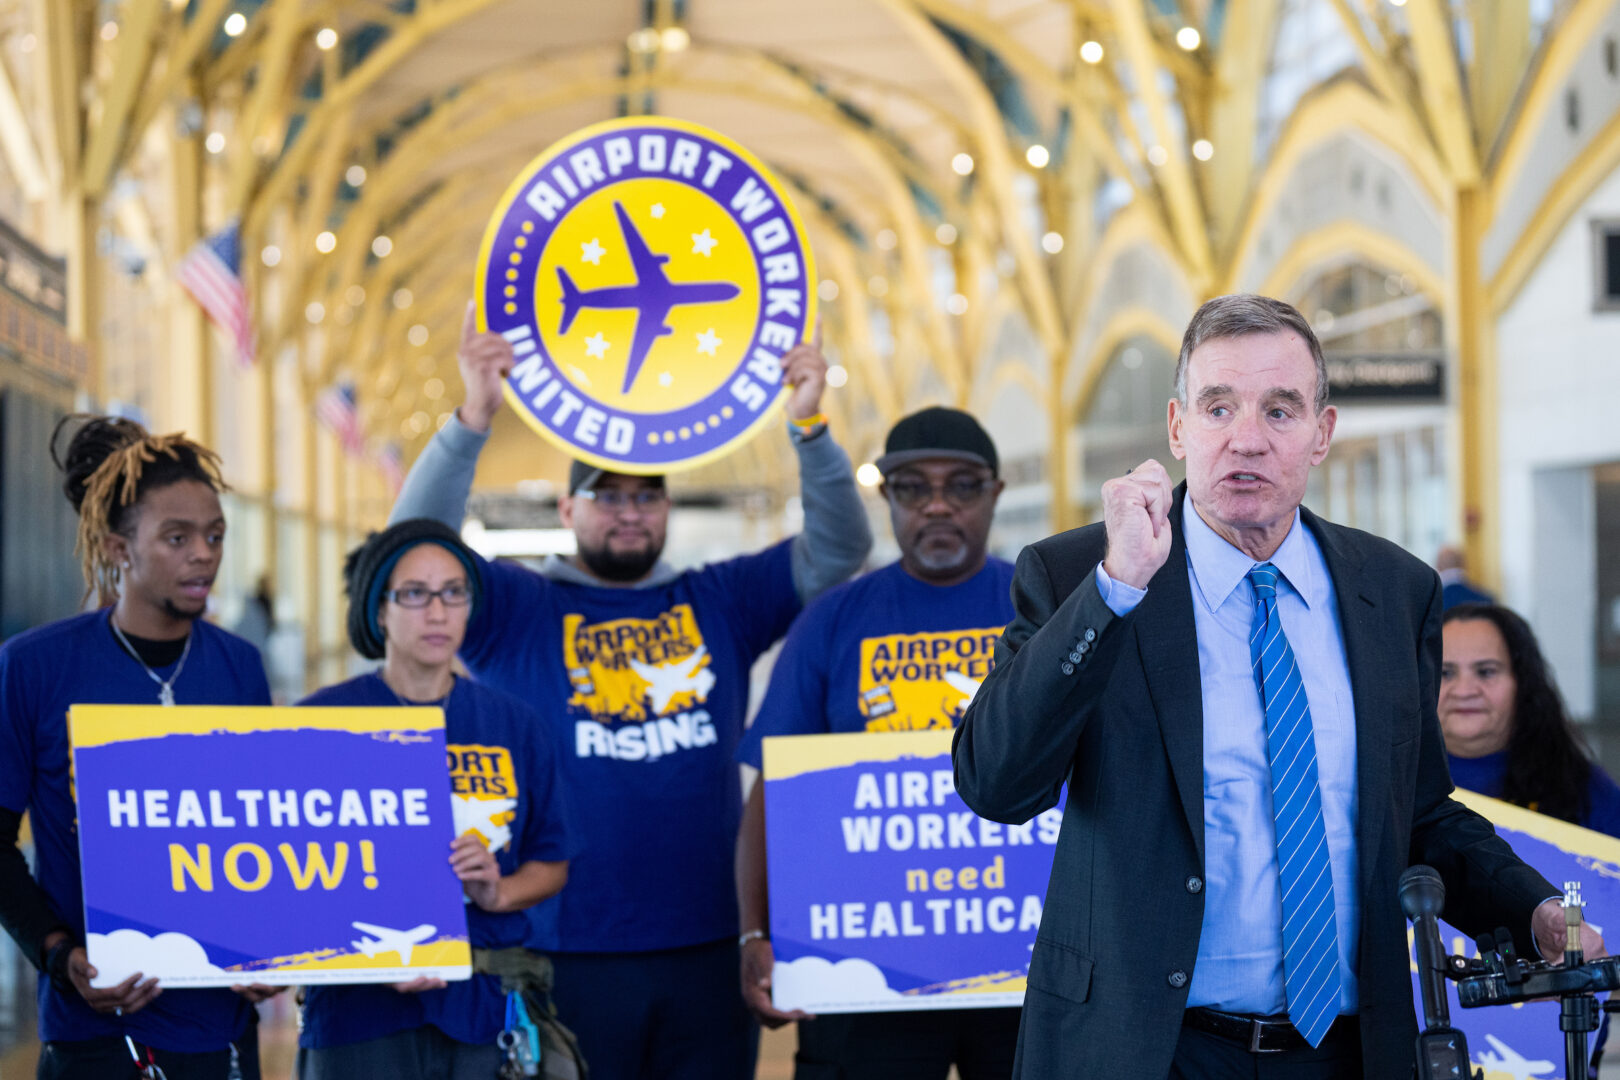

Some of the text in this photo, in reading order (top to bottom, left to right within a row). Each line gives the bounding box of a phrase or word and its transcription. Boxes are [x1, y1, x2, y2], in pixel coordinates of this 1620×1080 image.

[526, 134, 801, 411] AIRPORT WORKERS
[502, 324, 635, 455] UNITED
[573, 611, 684, 651] ARPORT
[873, 634, 999, 661] AIRPOR
[871, 656, 996, 683] WORKE
[107, 788, 431, 828] HEALTHCARE
[853, 769, 955, 810] AIRP
[841, 807, 1063, 853] WORKERS
[168, 839, 380, 892] NOW!
[906, 855, 1006, 893] need
[809, 895, 1043, 940] HEALTHCA
